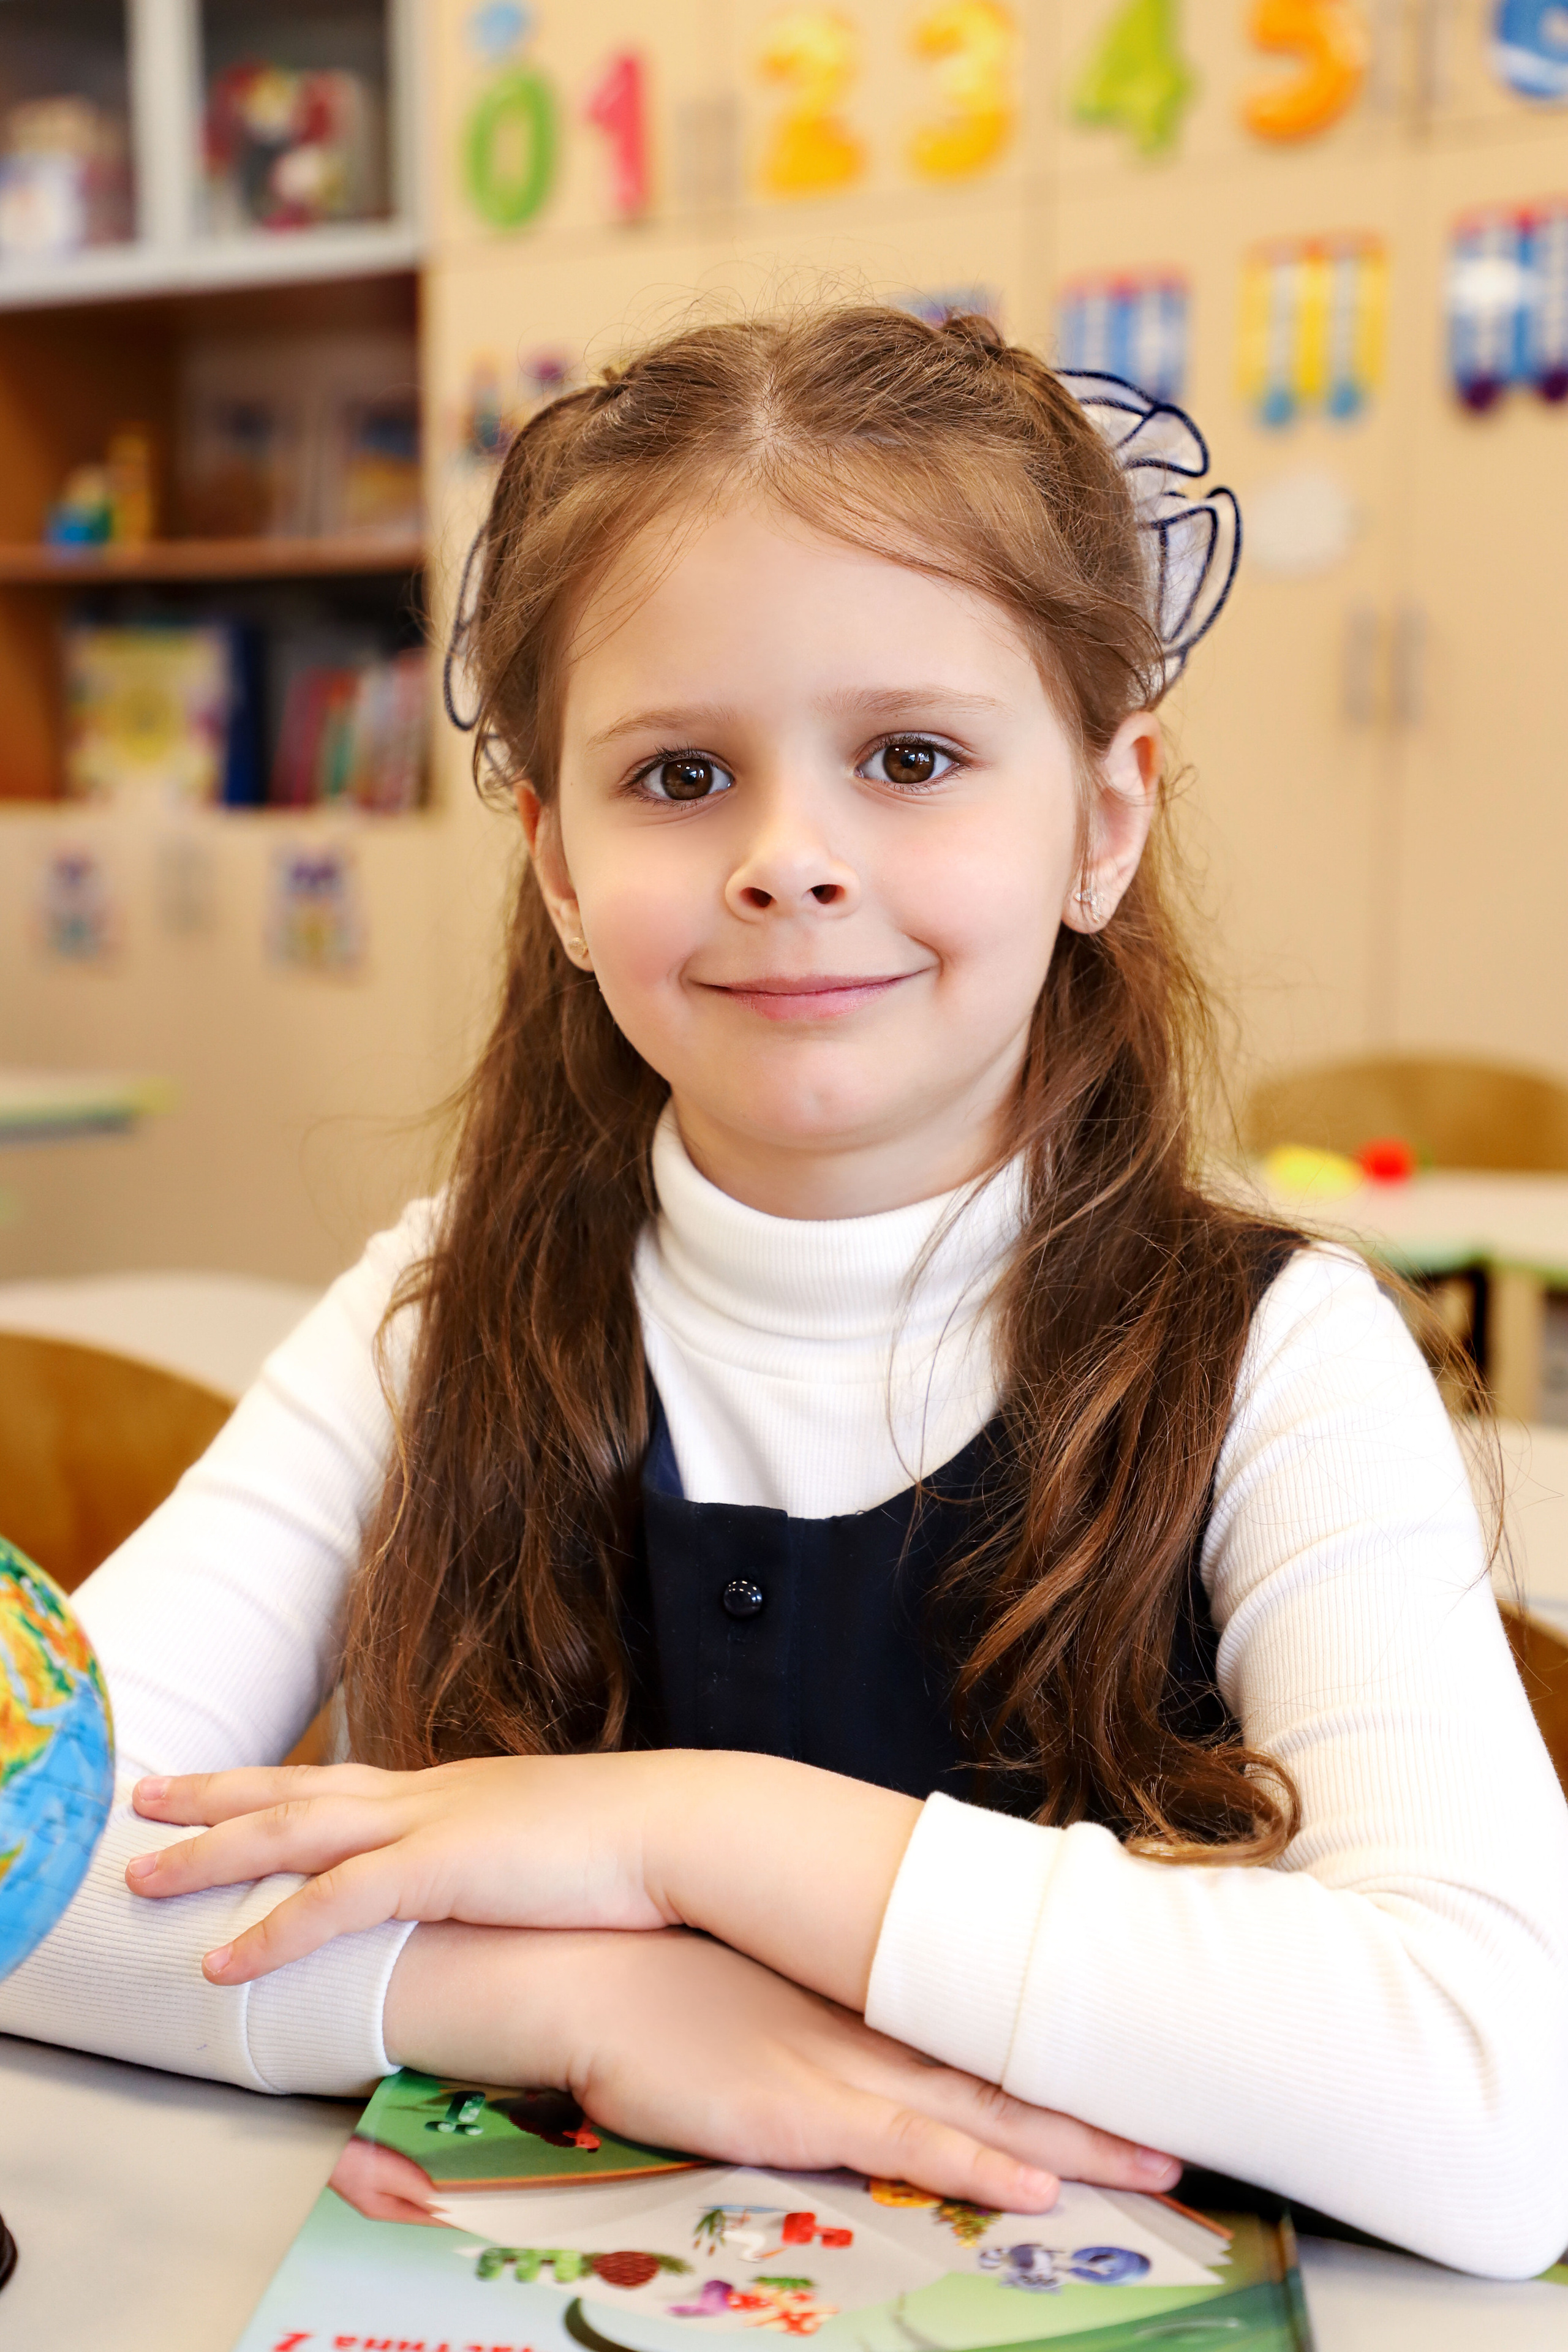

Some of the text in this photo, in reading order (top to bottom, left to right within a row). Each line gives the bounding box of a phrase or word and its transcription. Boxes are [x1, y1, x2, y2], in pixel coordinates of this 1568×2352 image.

[584, 50, 650, 222] 1
[758, 9, 867, 198] 2
[909, 0, 1018, 182] 3
[1071, 0, 1196, 162] 4
[1243, 0, 1367, 147] 5
